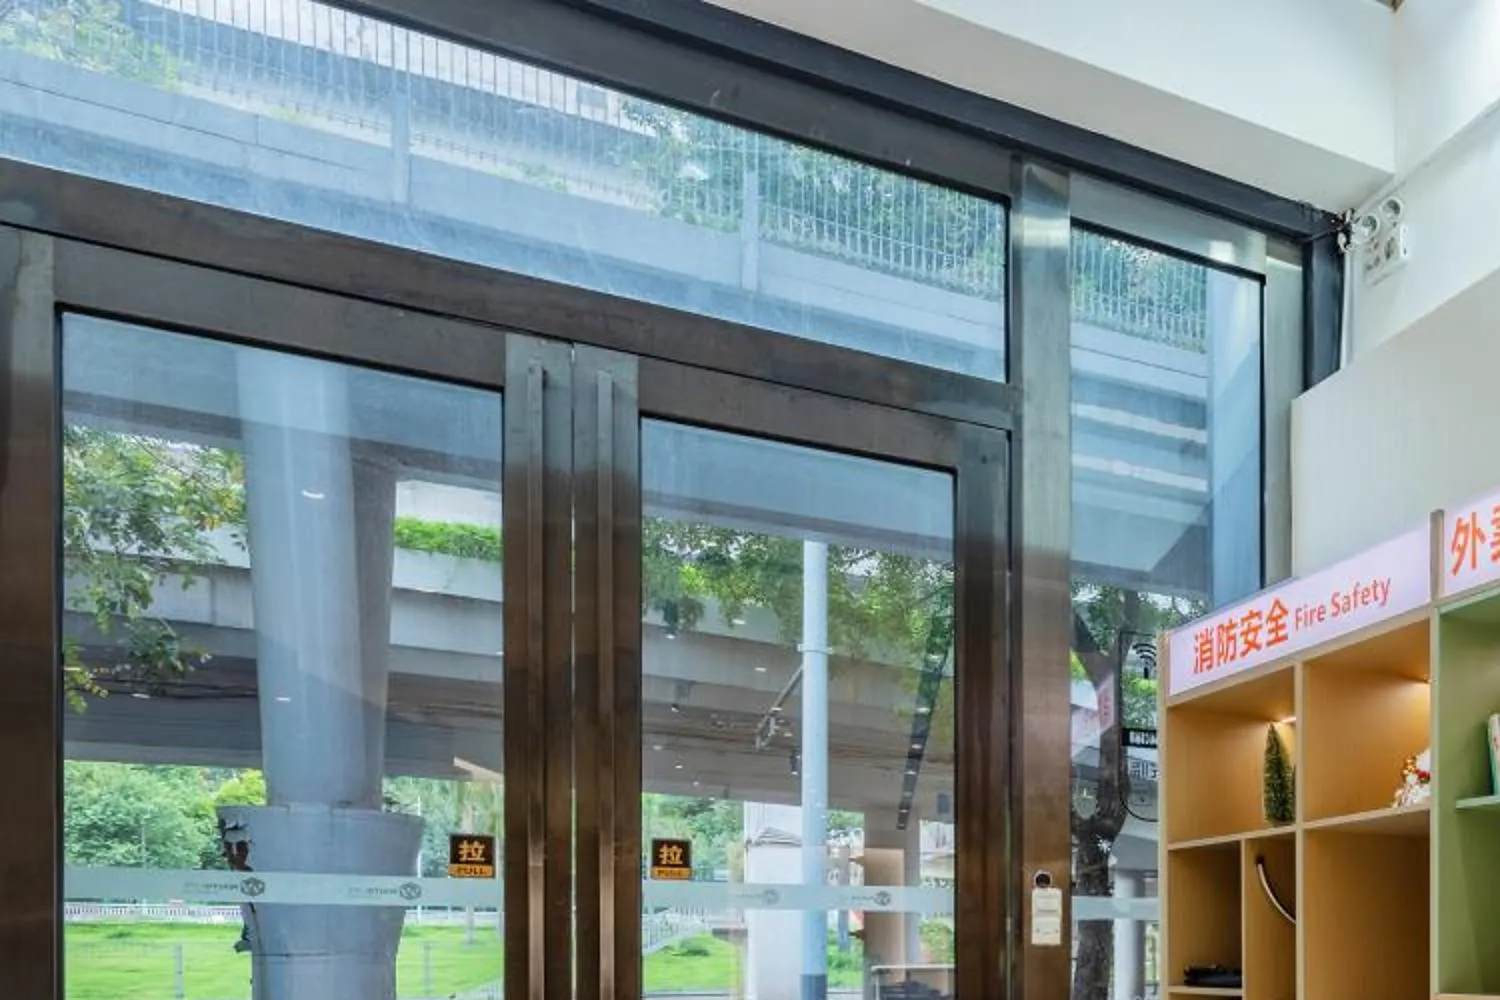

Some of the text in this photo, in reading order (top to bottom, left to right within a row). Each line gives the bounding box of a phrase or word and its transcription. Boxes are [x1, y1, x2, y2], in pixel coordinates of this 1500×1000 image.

[1294, 576, 1392, 634] Fire Safety
[1193, 597, 1290, 675] 消防安全
[457, 839, 486, 862] 拉
[657, 844, 684, 865] 拉
